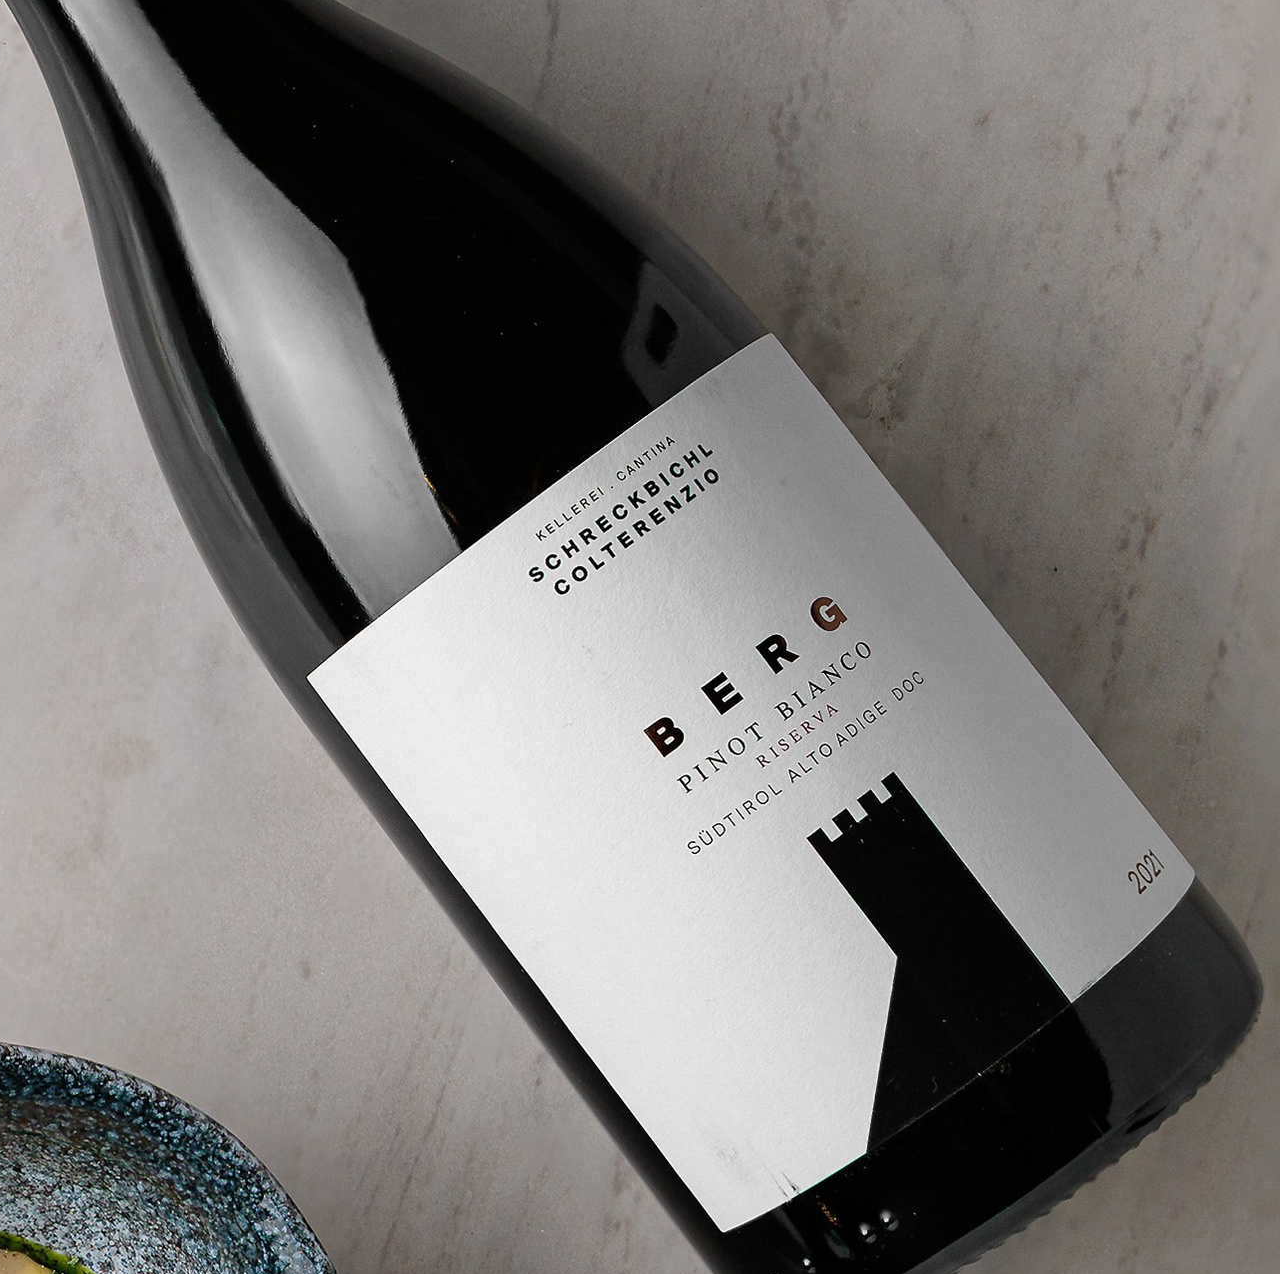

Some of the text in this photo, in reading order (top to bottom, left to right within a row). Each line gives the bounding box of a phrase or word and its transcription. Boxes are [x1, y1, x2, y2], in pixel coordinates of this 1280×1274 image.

[528, 443, 714, 583] SCHRECKBICHL
[534, 436, 676, 542] KELLEREI CANTINA
[553, 468, 720, 596] COLTERENZIO
[643, 596, 848, 758] BERG
[676, 641, 872, 794] PINOT BIANCO
[755, 704, 839, 769] RISERVA
[686, 671, 925, 855] SÜDTIROL ALTO ADIGE DOC
[1127, 848, 1166, 895] 2021
